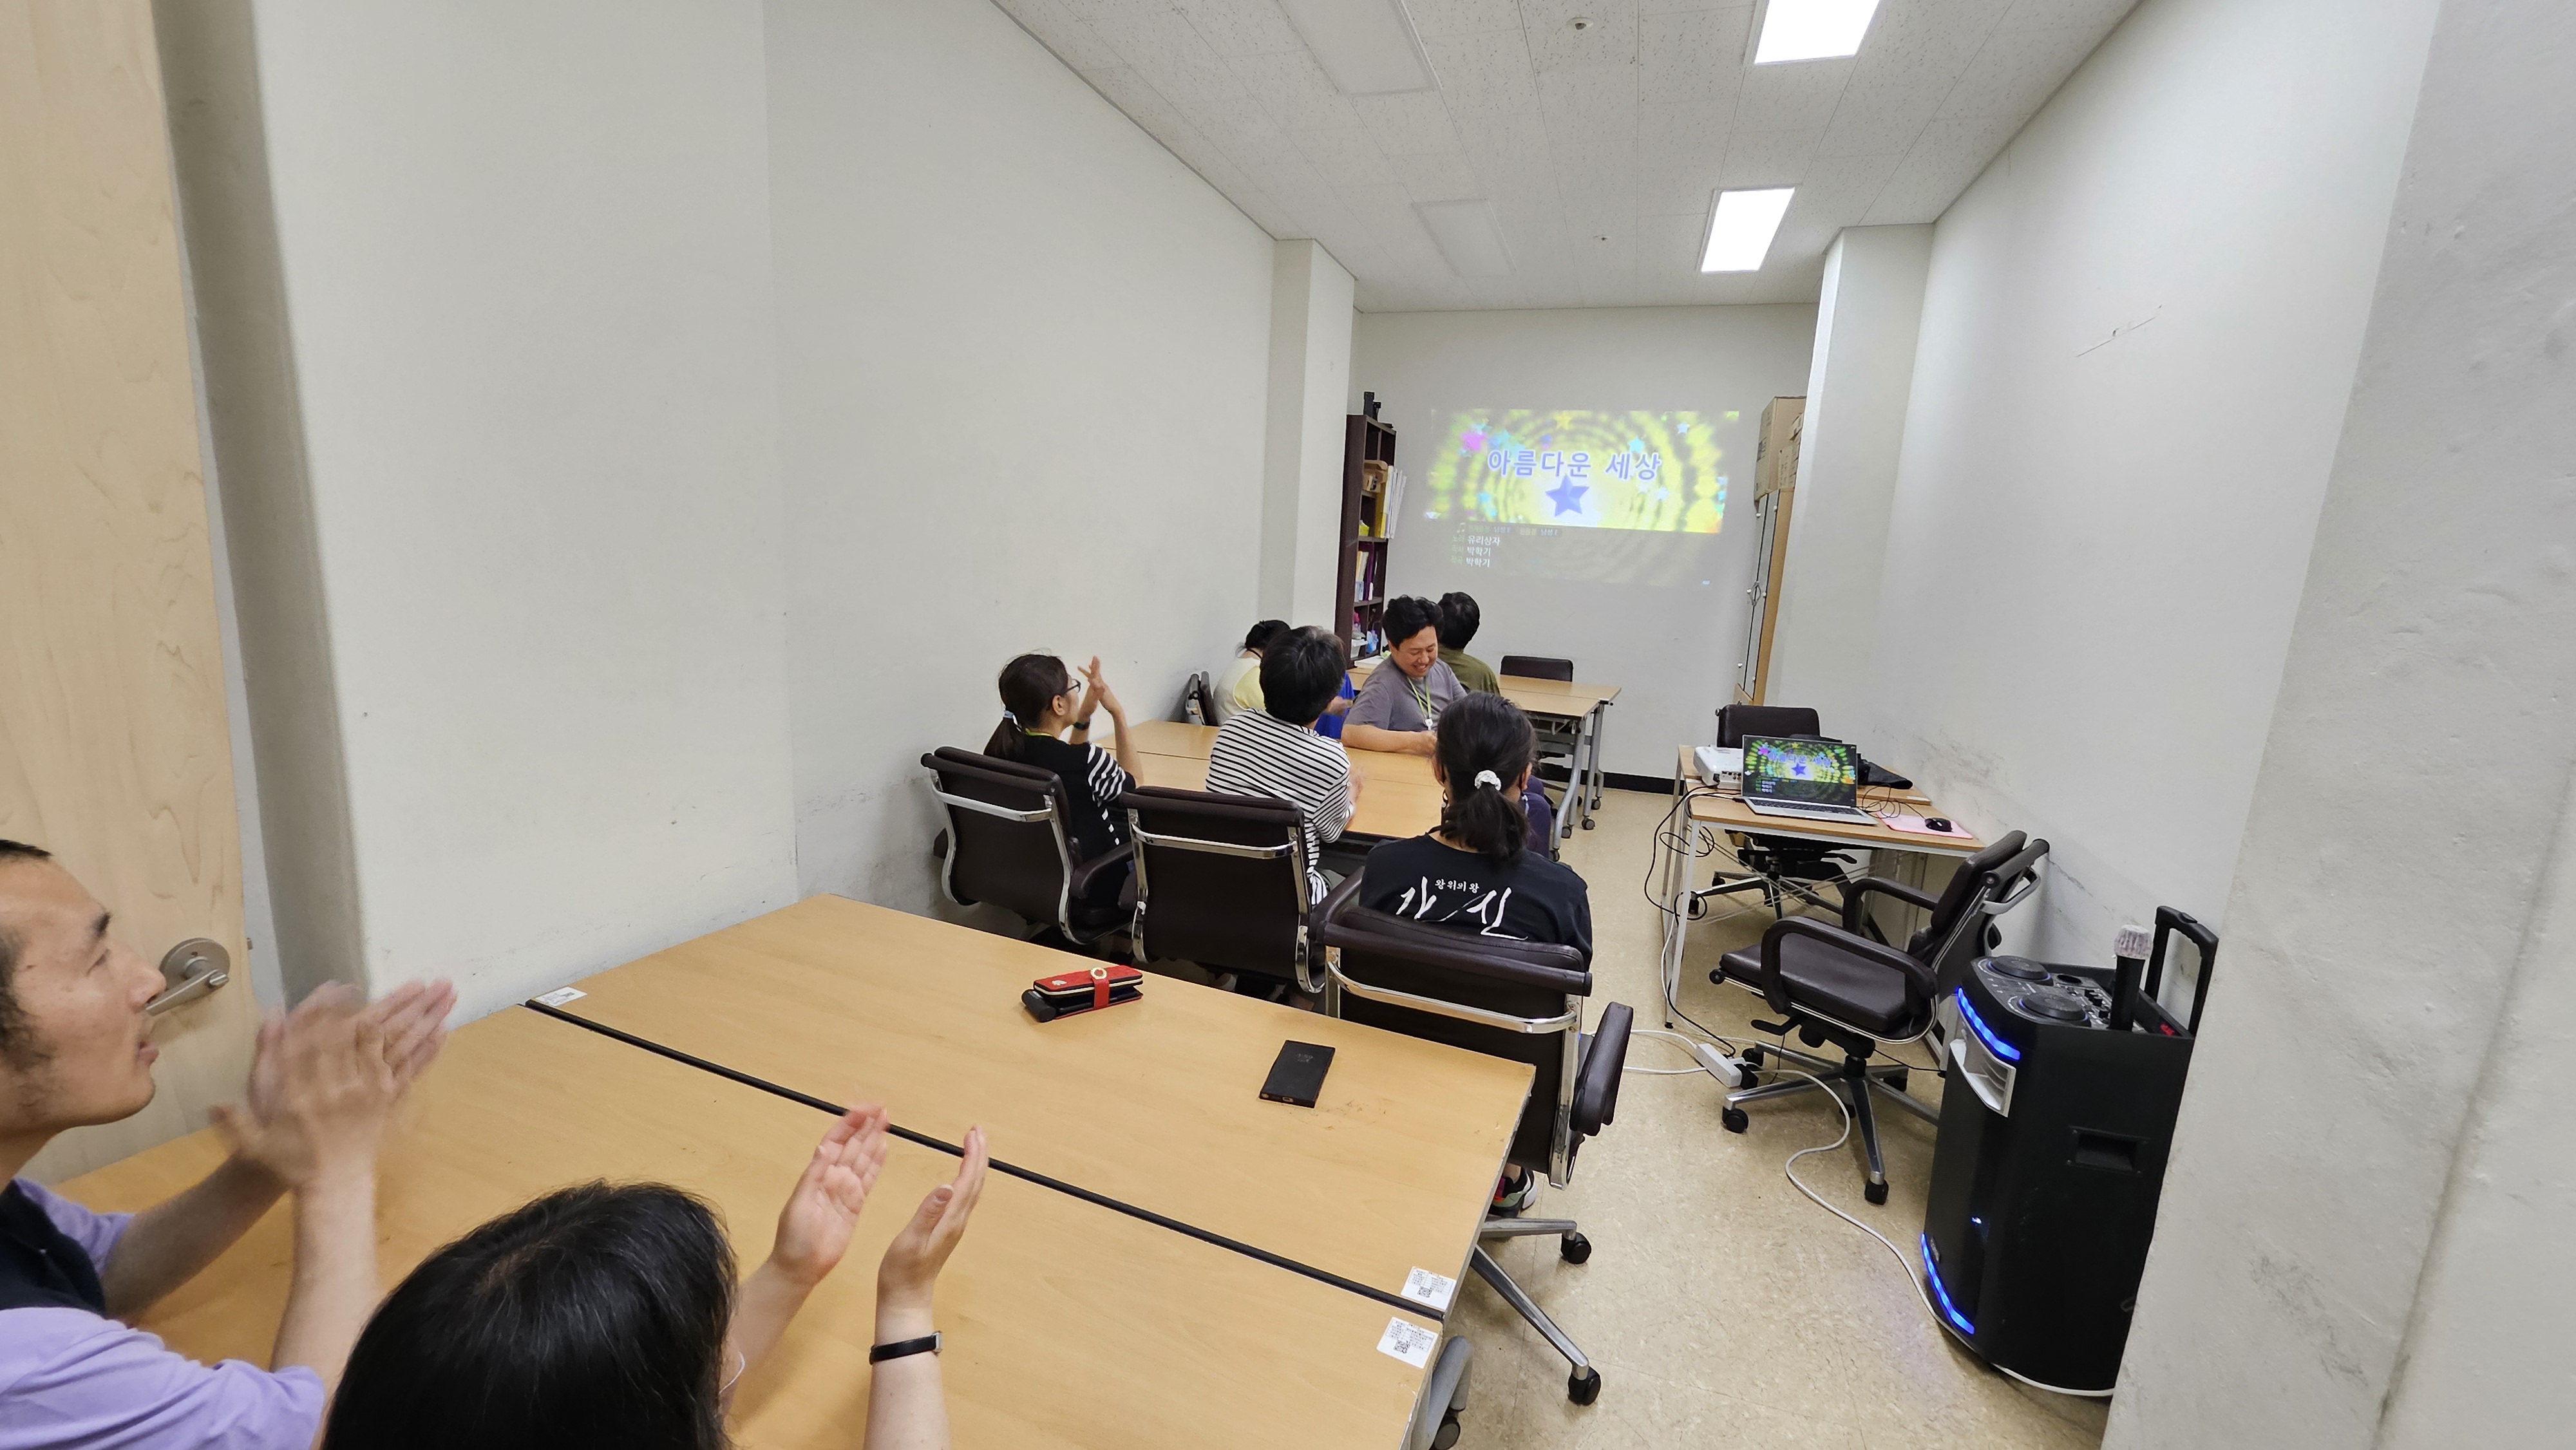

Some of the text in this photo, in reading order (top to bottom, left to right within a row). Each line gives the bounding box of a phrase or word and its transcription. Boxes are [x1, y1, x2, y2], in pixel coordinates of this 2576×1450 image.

[1488, 449, 1662, 481] 아름다운 세상
[1467, 535, 1501, 546] 유리상자
[1467, 546, 1492, 557] 박학기
[1466, 557, 1490, 568] 박학기
[1435, 878, 1446, 890] 왕
[1469, 883, 1480, 894] 왕
